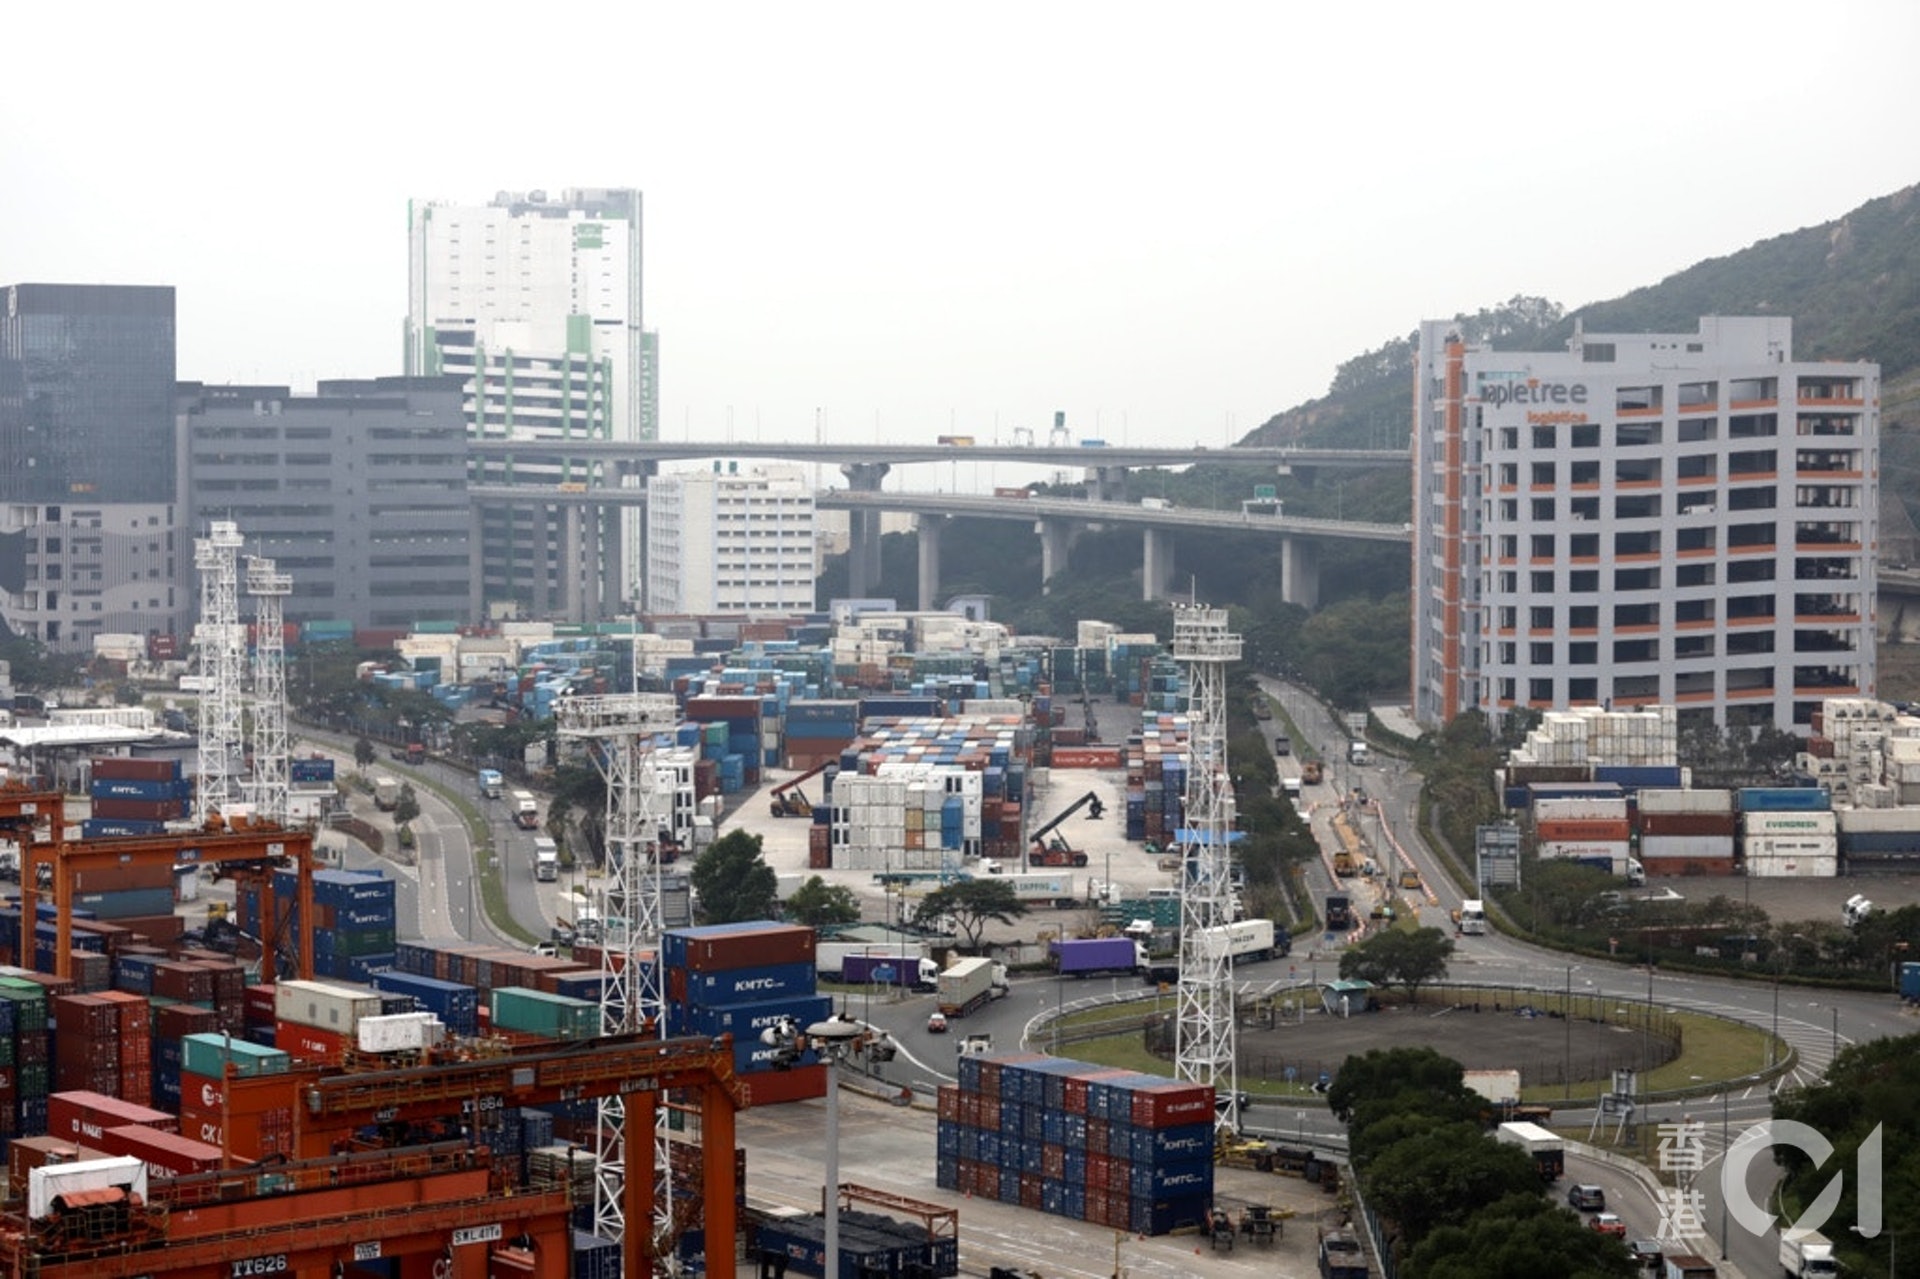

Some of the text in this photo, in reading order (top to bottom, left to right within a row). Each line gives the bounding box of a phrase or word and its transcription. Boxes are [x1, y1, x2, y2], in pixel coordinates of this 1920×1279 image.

[354, 890, 379, 899] KMTC
[355, 914, 379, 923] KMTC
[735, 978, 774, 991] KMTC
[200, 1122, 216, 1143] CK
[1164, 1138, 1194, 1150] KMTC
[1163, 1173, 1193, 1187] KMTC
[231, 1255, 287, 1277] TT626
